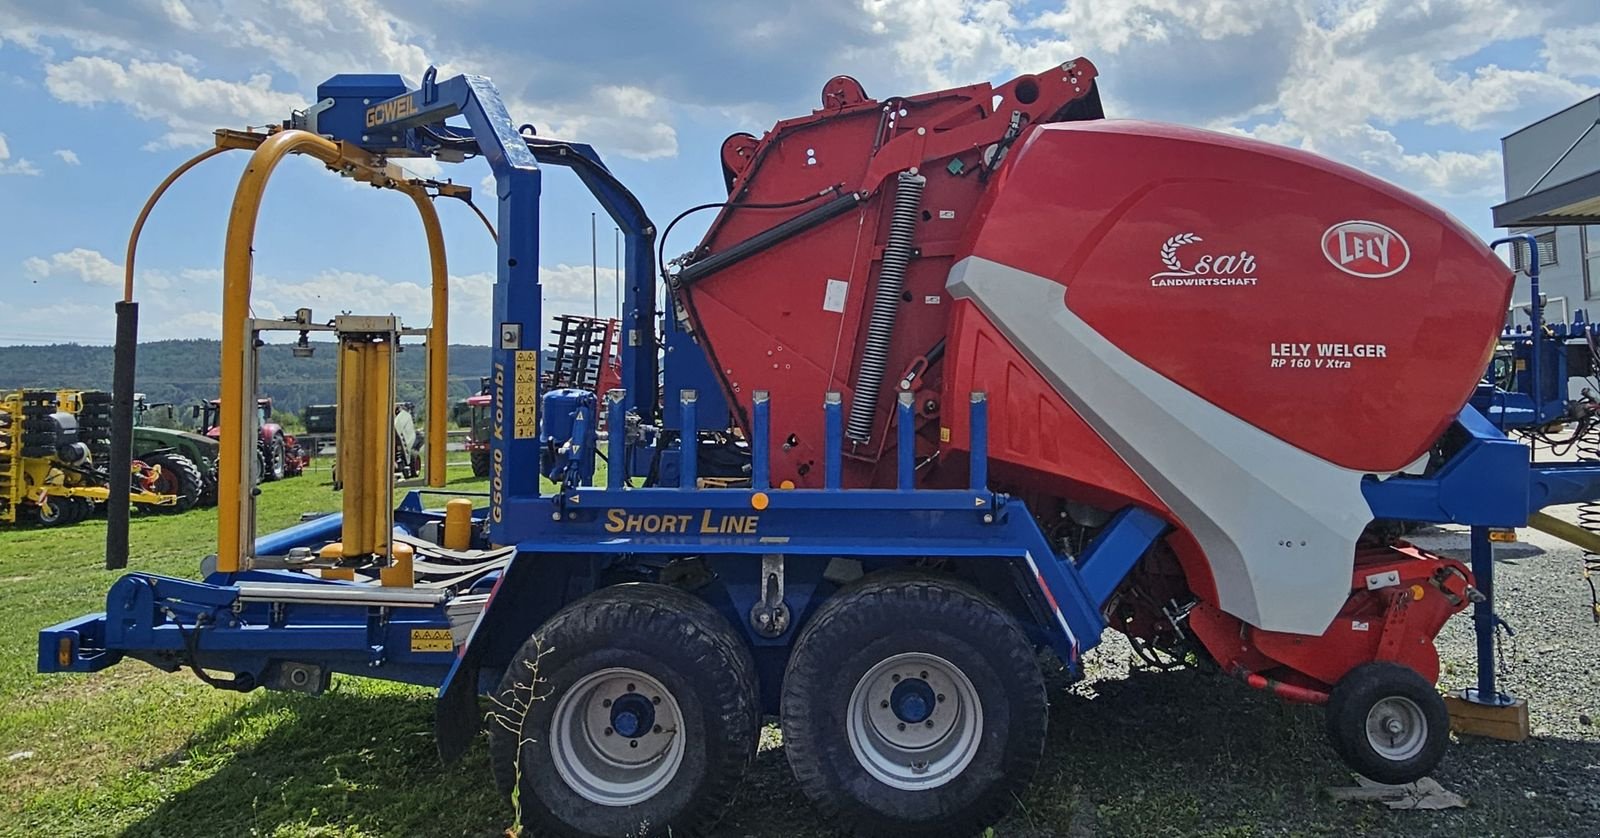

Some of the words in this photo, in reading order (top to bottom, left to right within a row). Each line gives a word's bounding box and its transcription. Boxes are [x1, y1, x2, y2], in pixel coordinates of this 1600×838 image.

[1339, 230, 1389, 267] LELY
[1151, 278, 1258, 287] LANDWIRTSCHAFT
[1270, 343, 1311, 356] LELY
[1316, 343, 1387, 357] WELGER
[1270, 358, 1286, 368] RP
[1289, 358, 1311, 368] 160
[1315, 359, 1323, 368] V
[1325, 359, 1351, 369] Xtra
[494, 363, 504, 440] Kombi
[604, 508, 693, 533] SHORT
[700, 509, 759, 533] LINE
